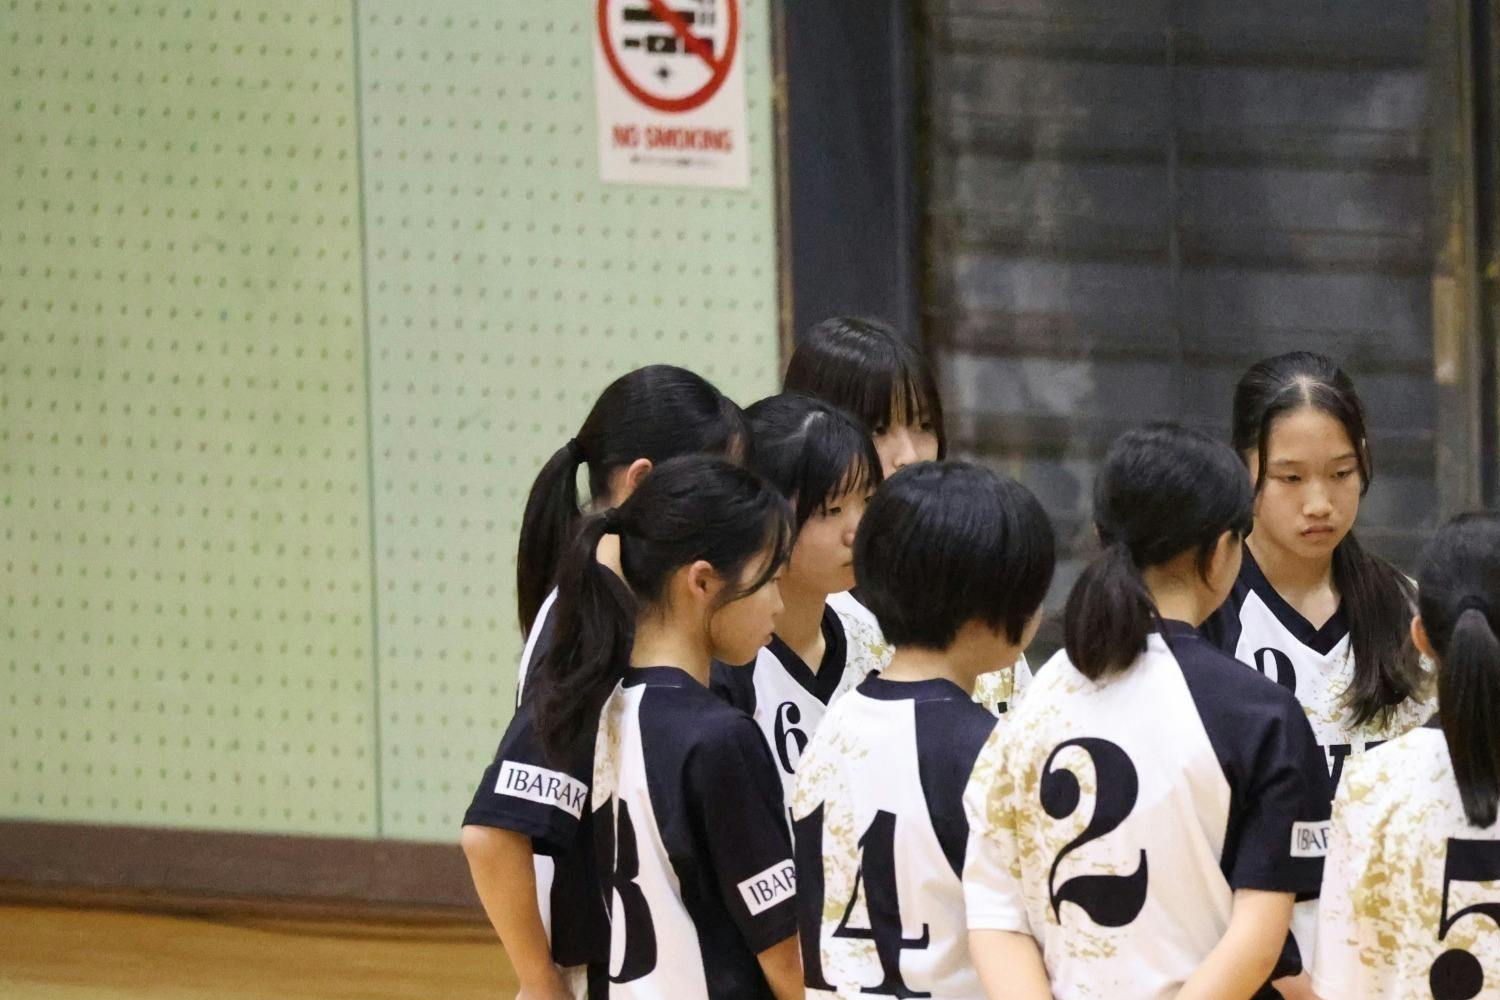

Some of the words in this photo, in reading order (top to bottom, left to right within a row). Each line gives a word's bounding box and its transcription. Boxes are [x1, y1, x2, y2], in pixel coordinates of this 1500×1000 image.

[613, 125, 639, 149] NO
[645, 126, 732, 153] SMOKING
[774, 701, 809, 775] 6
[1039, 737, 1148, 928] 2
[789, 800, 932, 1000] 14
